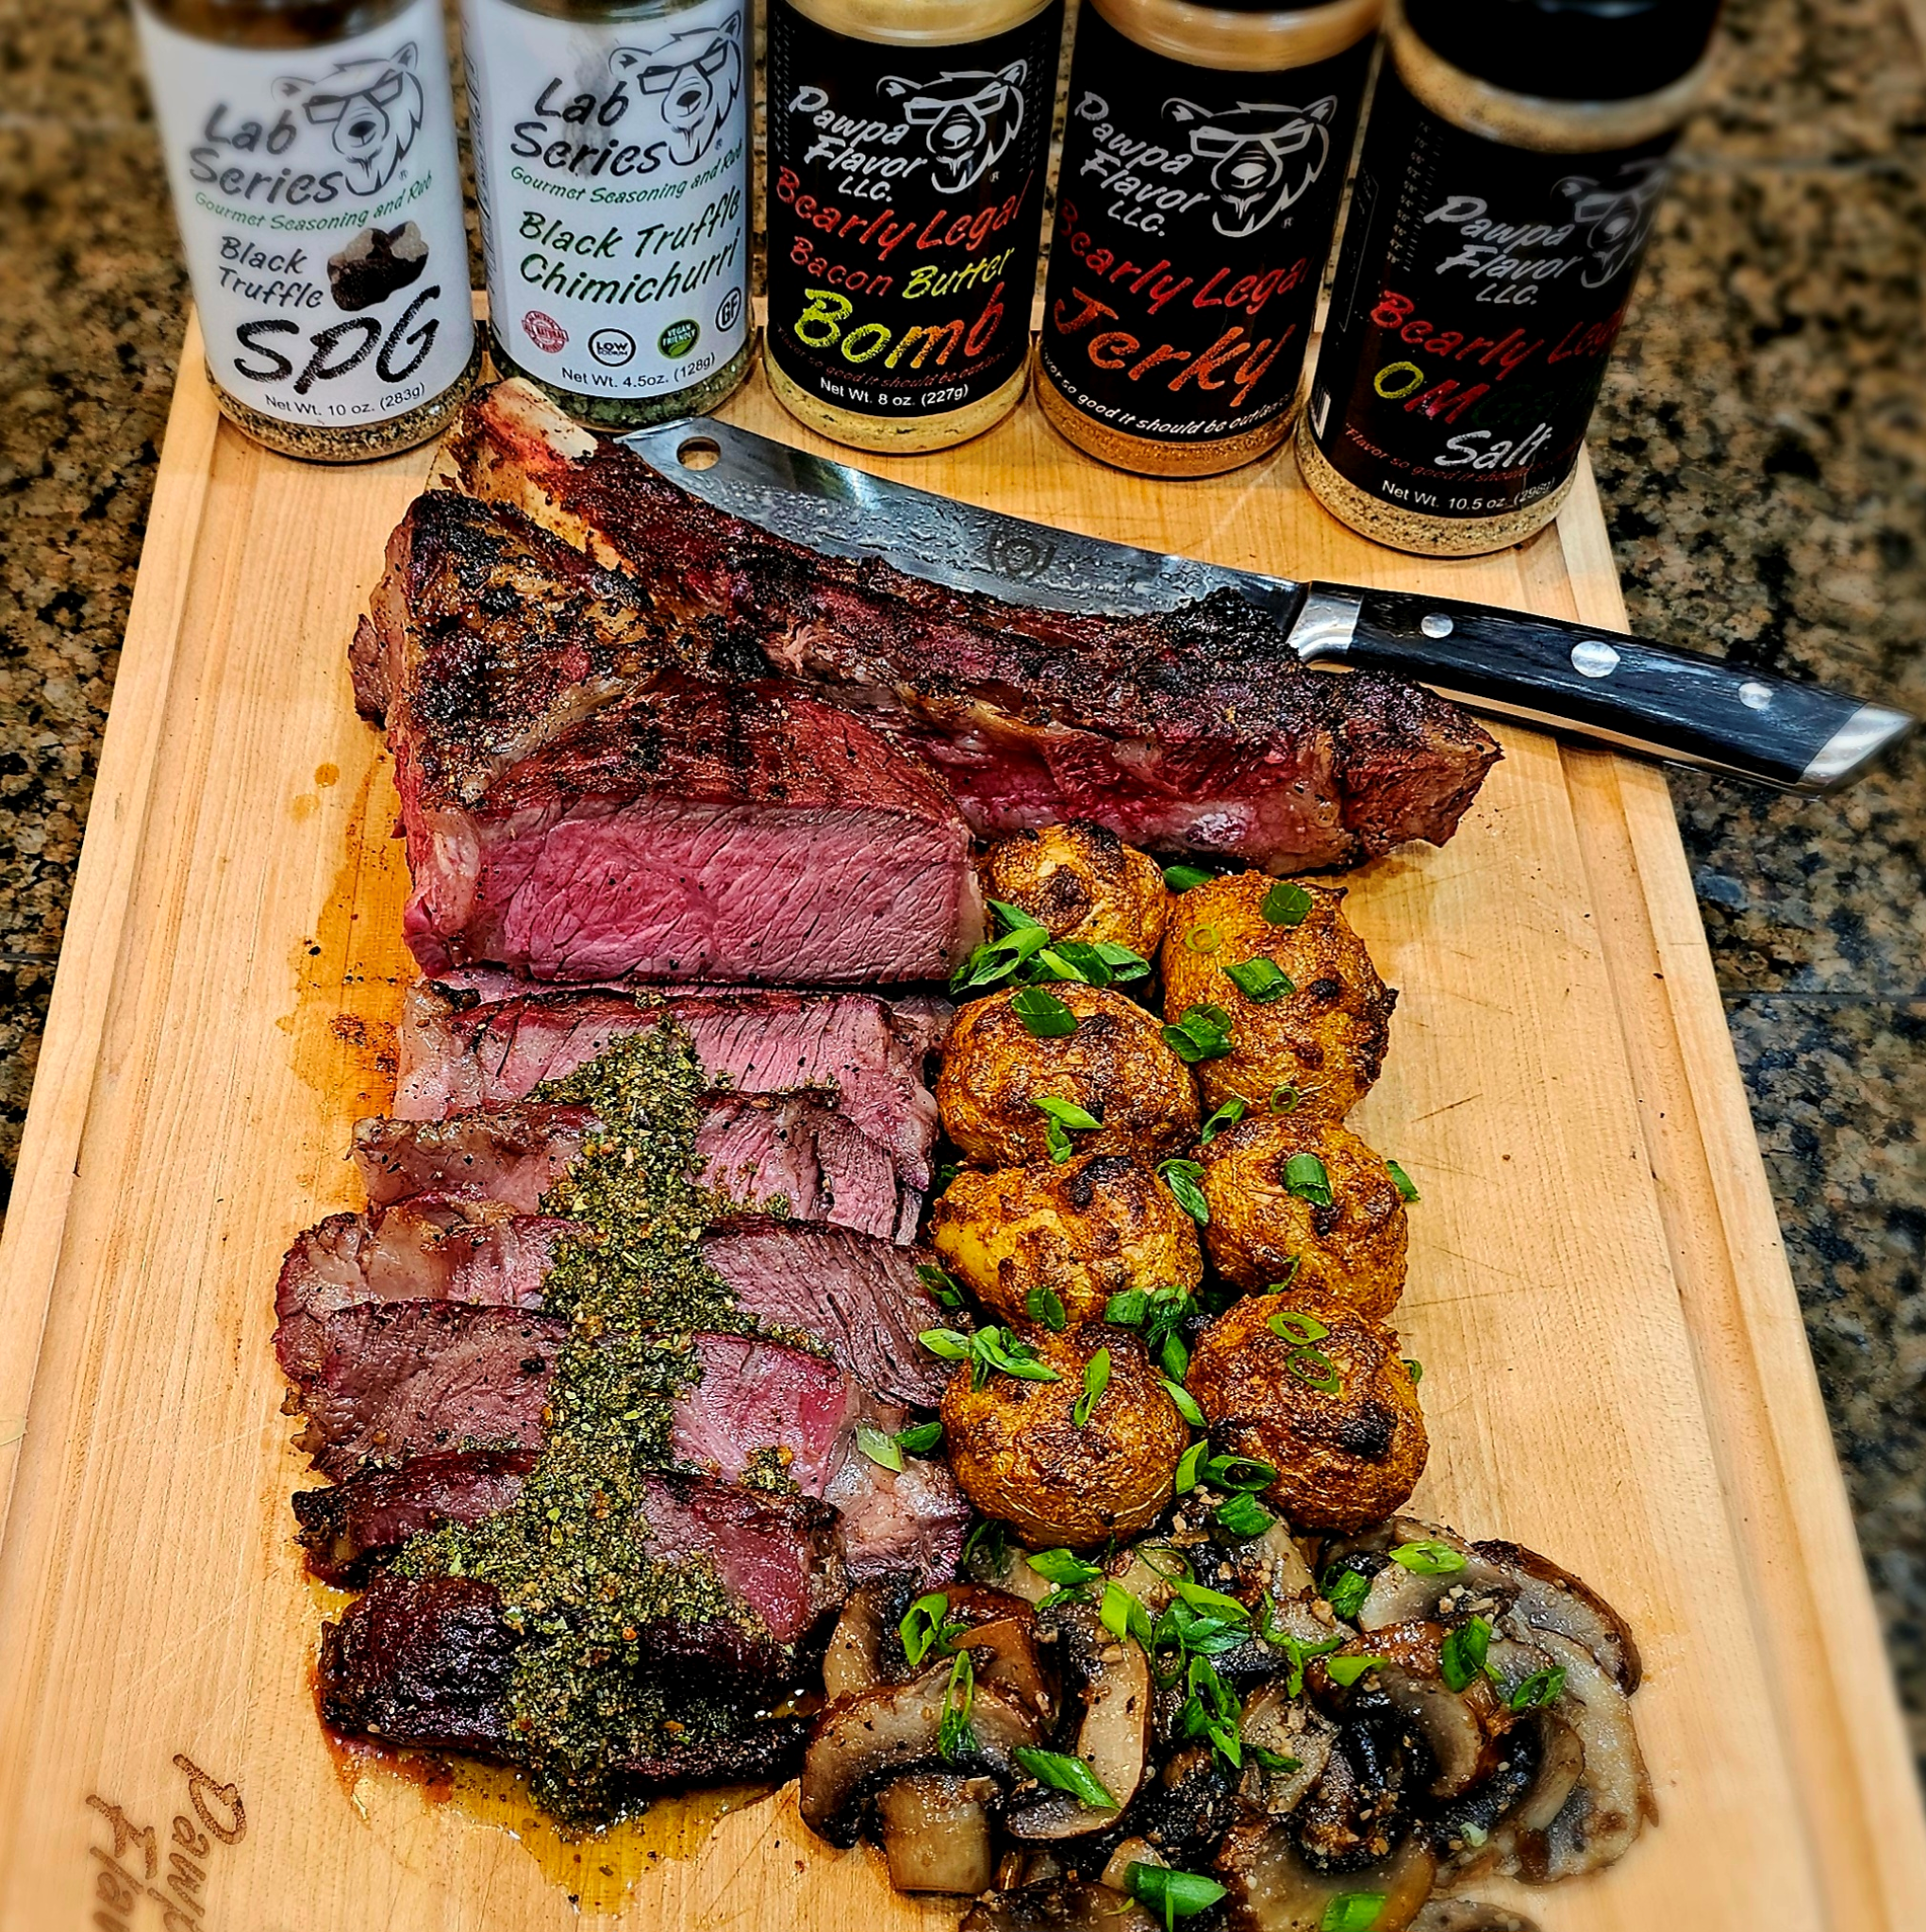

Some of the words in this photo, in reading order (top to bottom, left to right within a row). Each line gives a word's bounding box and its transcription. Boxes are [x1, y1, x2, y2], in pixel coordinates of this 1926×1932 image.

[534, 77, 630, 127] Lab
[789, 85, 910, 145] Pawpa
[205, 103, 298, 156] Lab
[510, 122, 668, 176] Series
[804, 134, 927, 178] Flavor
[1074, 92, 1193, 175] Pawpa
[189, 147, 343, 206] Series
[195, 191, 267, 227] Gourmet
[270, 208, 369, 231] Seasoning
[373, 193, 404, 219] and
[407, 171, 433, 205] Rub
[510, 166, 587, 201] Gourmet
[589, 179, 688, 204] Seasoning
[690, 158, 722, 190] and
[838, 175, 892, 202] LLC.
[1081, 149, 1211, 213] Flavor
[519, 210, 623, 258] Black
[637, 185, 741, 258] Truffle
[776, 166, 915, 260] Bearly
[916, 169, 1034, 251] Legal
[1107, 200, 1165, 237] LLC.
[1423, 195, 1576, 252] Pawpa
[219, 236, 307, 275] Black
[520, 226, 741, 304] Chimichurri
[790, 237, 893, 296] Bacon
[902, 246, 1015, 299] Butter
[1059, 198, 1193, 314] Bearly
[1436, 244, 1583, 280] Flavor
[218, 265, 324, 308] Truffle
[722, 292, 738, 326] GF
[1476, 284, 1538, 306] LLC.
[234, 285, 440, 395] SPG
[596, 341, 629, 352] LOW
[794, 281, 1005, 369] Bomb
[1054, 287, 1296, 407] Jerky
[1370, 291, 1545, 380] Bearly
[562, 367, 588, 386] Net
[591, 374, 618, 389] Wt.
[623, 371, 670, 389] 4.5oz.
[673, 351, 716, 382] (128g)
[821, 376, 844, 397] Net
[848, 388, 873, 404] Wt.
[878, 393, 888, 406] 8
[892, 396, 916, 406] oz.
[921, 384, 969, 408] (227g)
[825, 366, 866, 383] good
[881, 374, 938, 388] should
[265, 393, 291, 412] Net
[296, 400, 322, 416] Wt.
[328, 399, 346, 415] 10
[351, 400, 374, 414] oz.
[379, 381, 425, 412] (283g)
[1061, 379, 1077, 393] so
[1077, 394, 1121, 418] good
[1119, 413, 1137, 425] it
[1136, 418, 1205, 434] should
[1204, 420, 1227, 434] be
[1389, 458, 1410, 469] so
[1411, 466, 1461, 480] good
[1434, 422, 1553, 470] Salt
[1382, 479, 1409, 501] Net
[1414, 491, 1440, 508] Wt.
[1449, 497, 1484, 510] 10.5
[147, 1753, 247, 1932] Pawp
